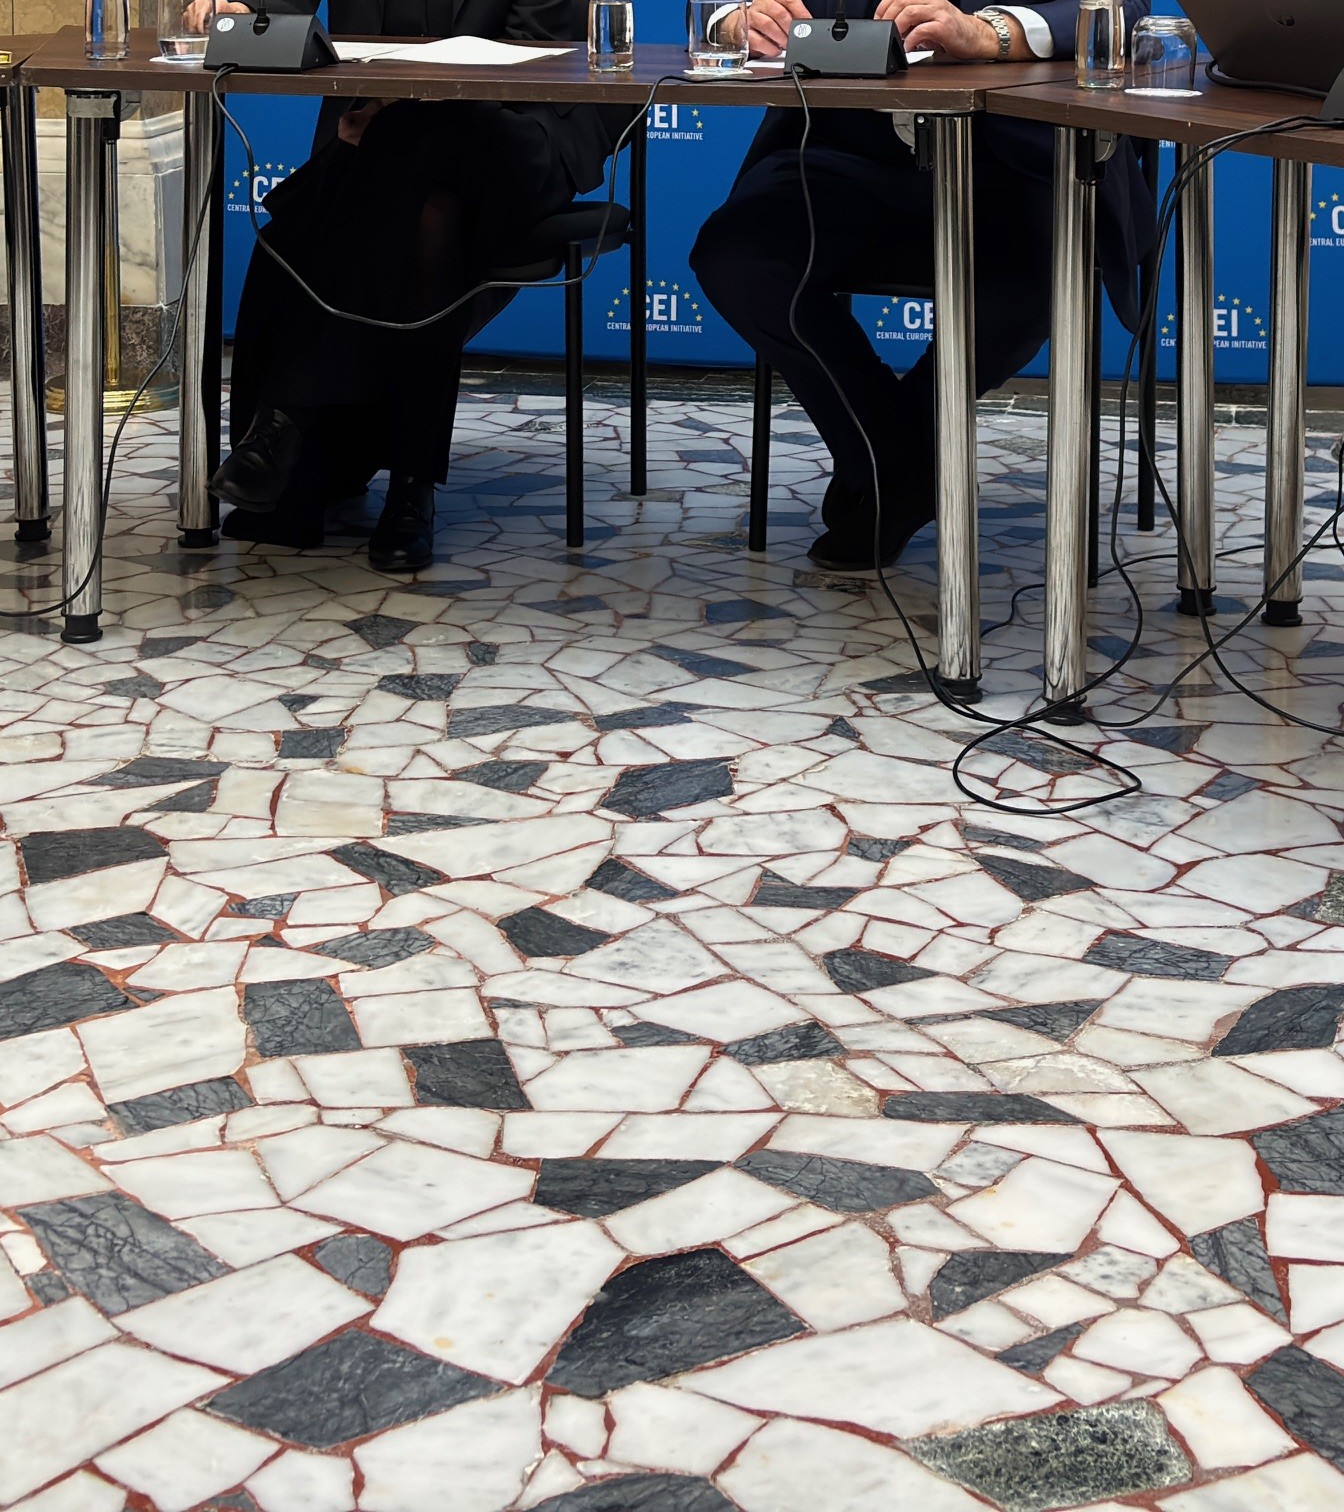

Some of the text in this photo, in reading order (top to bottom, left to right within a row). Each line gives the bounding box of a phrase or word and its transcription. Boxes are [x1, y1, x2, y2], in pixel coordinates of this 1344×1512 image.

[671, 132, 704, 141] INITIATIVE
[1309, 237, 1334, 246] ENTRAL
[903, 301, 934, 330] CE
[606, 322, 703, 333] CENTRA INITIATIVE
[876, 331, 933, 341] CENTRAL EUROPE
[1231, 340, 1267, 349] INITIATIVE
